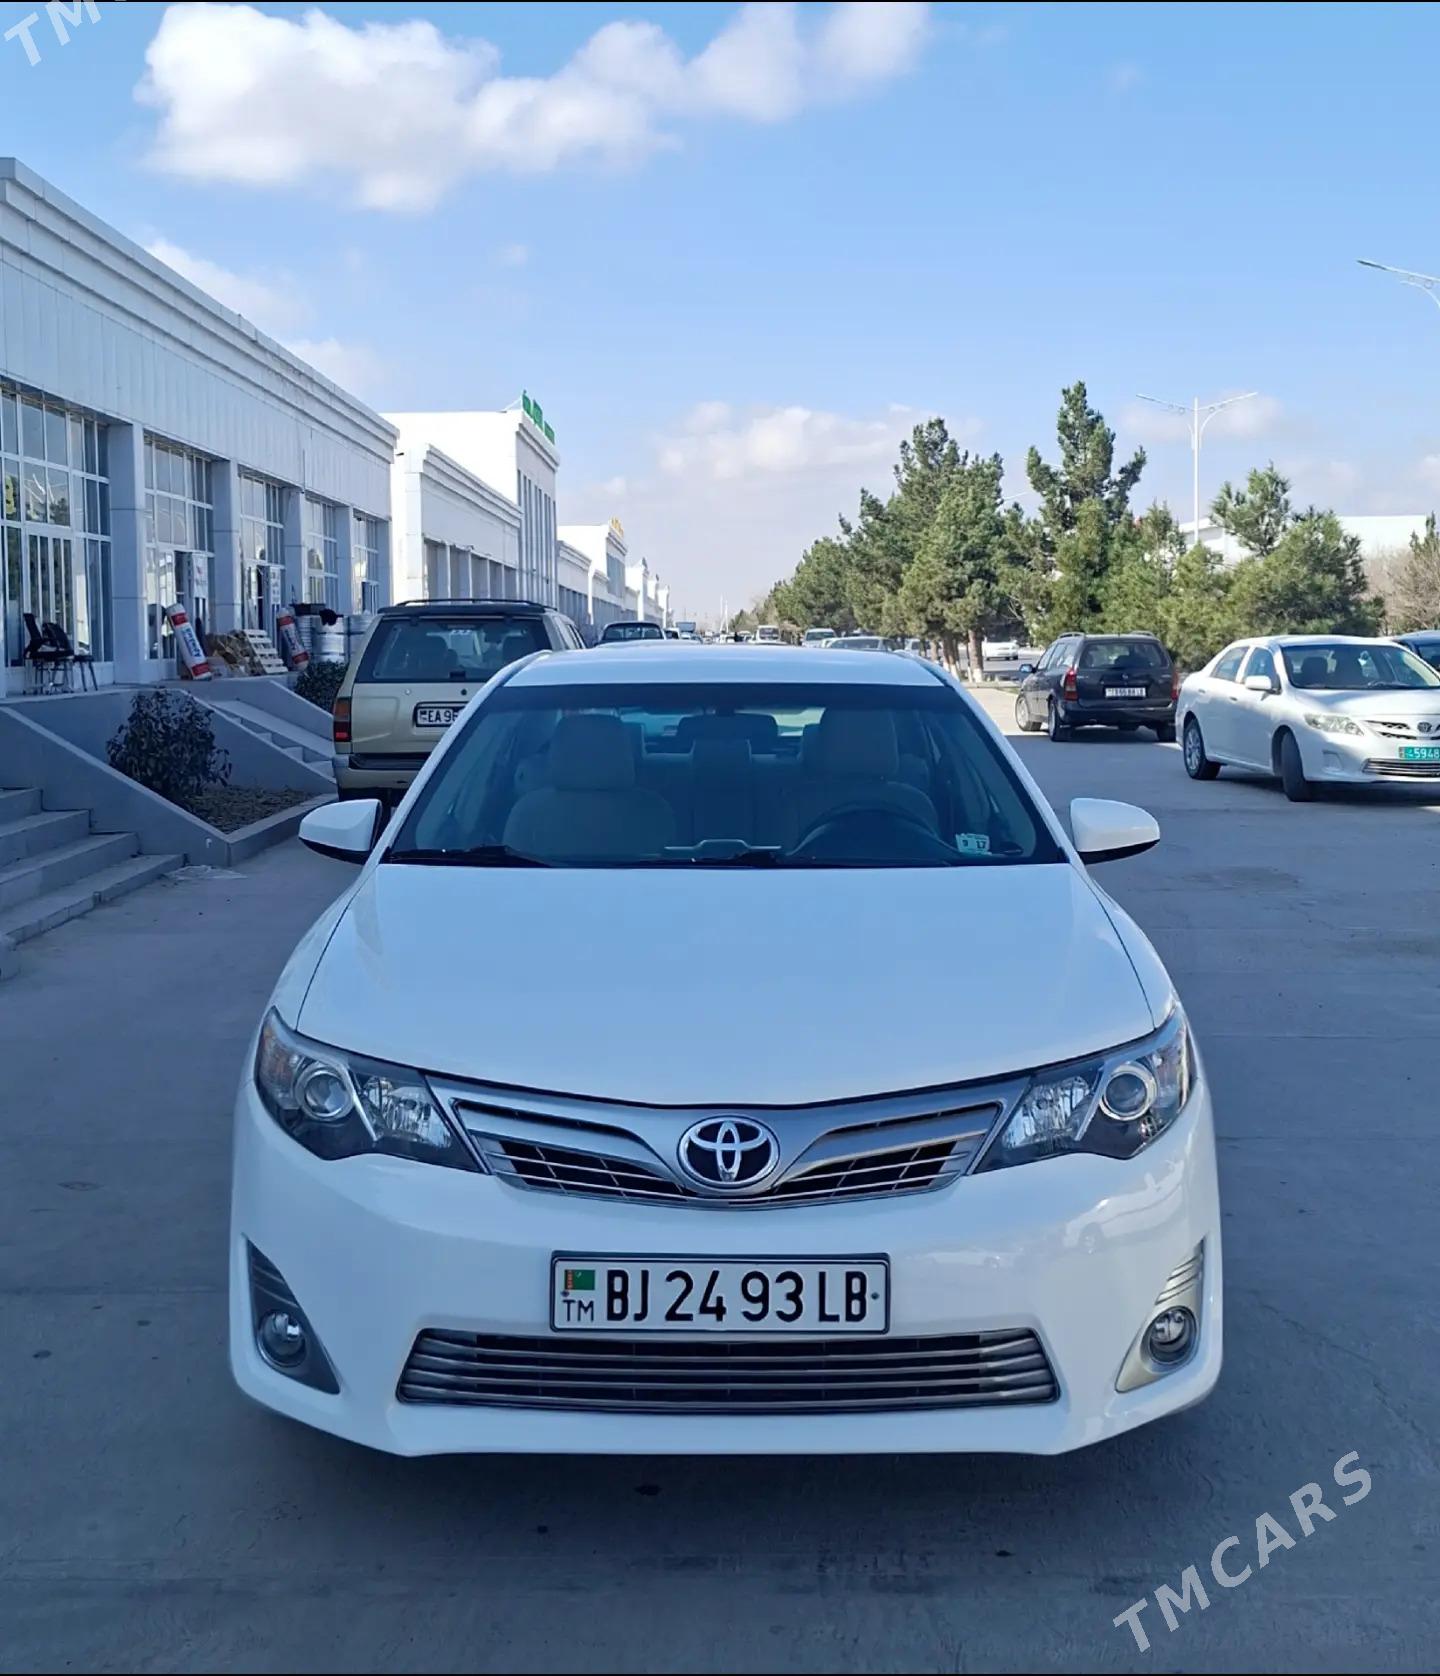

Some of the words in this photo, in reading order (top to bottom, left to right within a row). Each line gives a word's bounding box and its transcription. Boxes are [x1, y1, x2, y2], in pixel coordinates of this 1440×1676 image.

[563, 1299, 594, 1322] TM
[606, 1269, 650, 1322] BJ
[664, 1269, 727, 1322] 24
[740, 1270, 804, 1323] 93
[818, 1271, 868, 1323] LB
